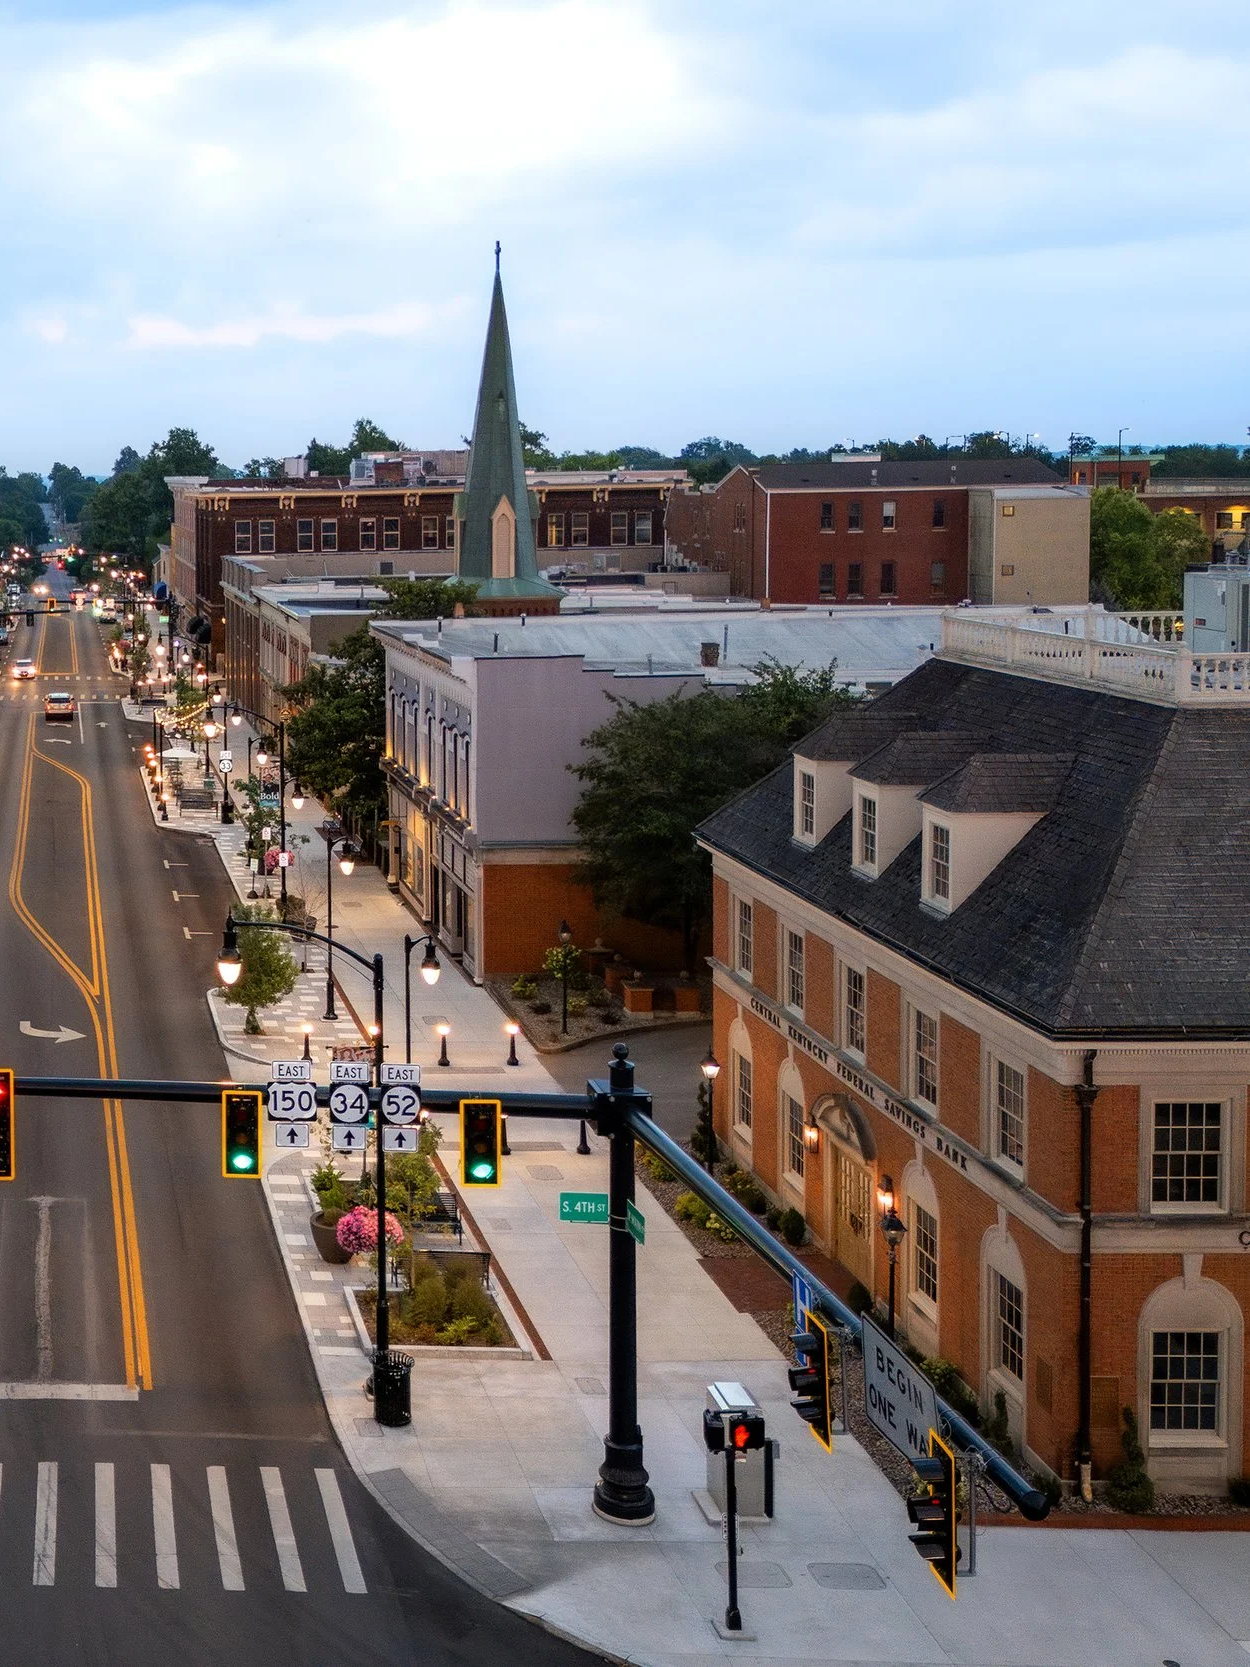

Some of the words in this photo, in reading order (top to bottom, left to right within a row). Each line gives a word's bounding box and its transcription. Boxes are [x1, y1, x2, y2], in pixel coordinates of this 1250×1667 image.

[221, 762, 231, 770] 33
[260, 792, 279, 800] Bold
[278, 1064, 305, 1077] EAST
[336, 1065, 362, 1079] EAST
[388, 1067, 414, 1081] EAST
[750, 997, 781, 1028] CENTRAL
[788, 1025, 829, 1064] KENTUCKY
[836, 1063, 875, 1101] FEDERAL
[884, 1098, 926, 1140] SAVINGS
[936, 1134, 968, 1172] BANK
[271, 1090, 312, 1112] 150
[334, 1093, 365, 1115] 34
[386, 1095, 416, 1117] 52
[562, 1201, 572, 1213] S.
[574, 1201, 595, 1214] 4TH
[596, 1203, 606, 1212] ST
[875, 1346, 923, 1415] BEGIN
[868, 1383, 897, 1430] ONE
[906, 1418, 929, 1458] WA
